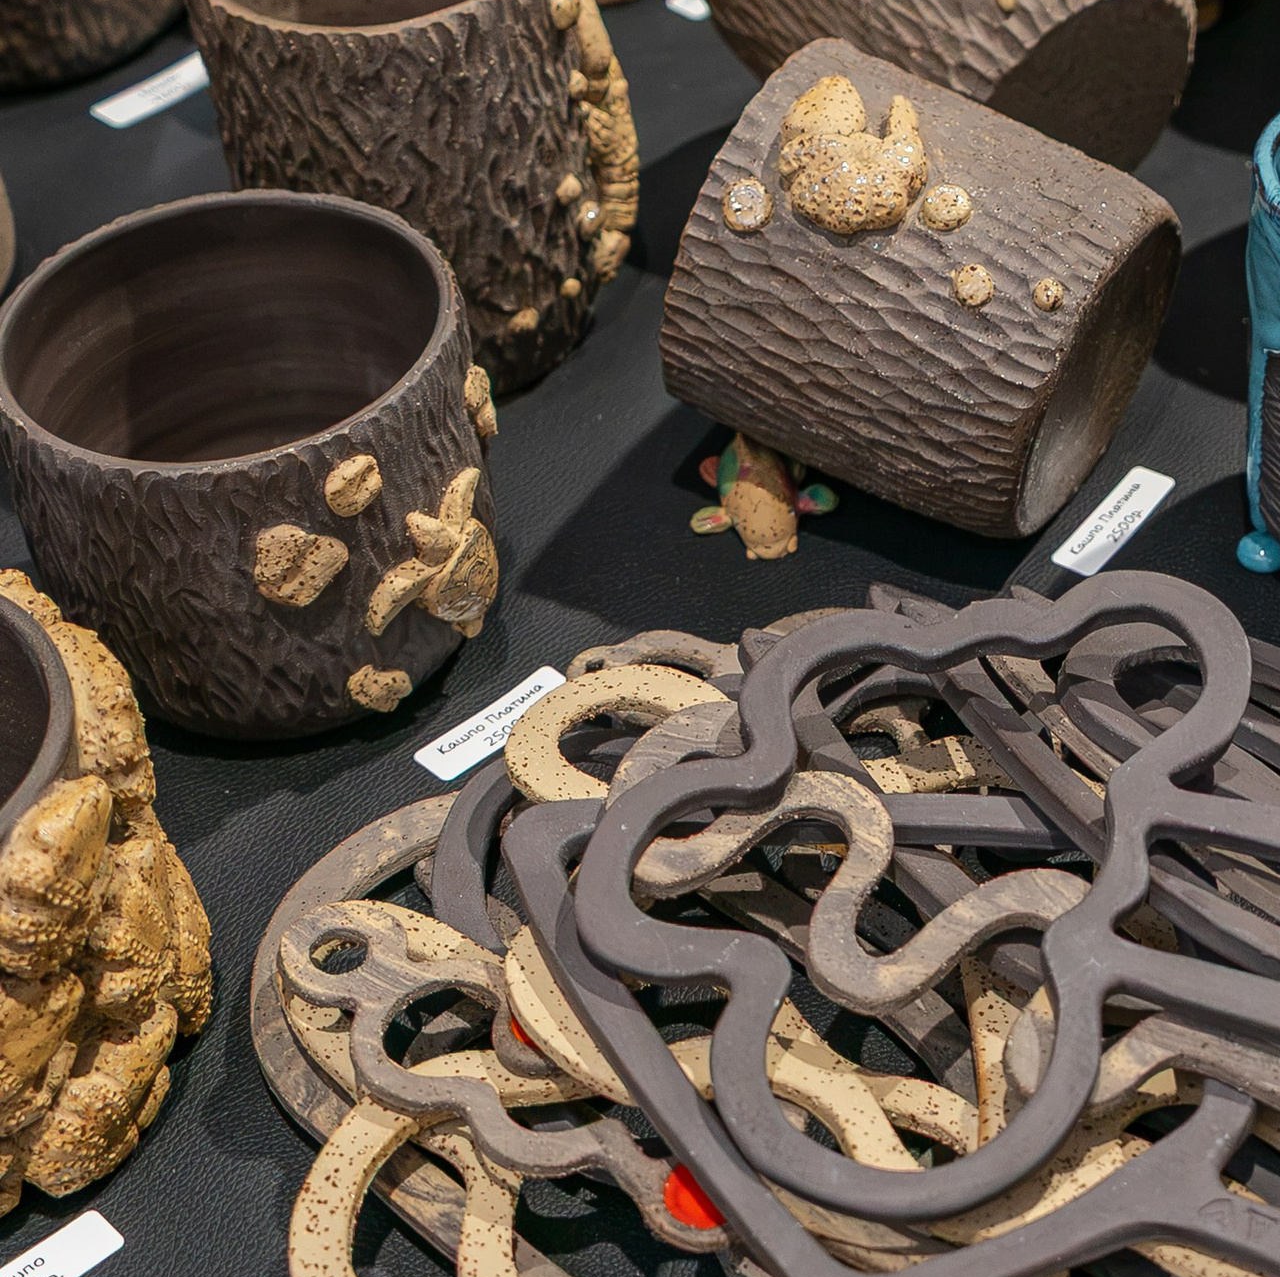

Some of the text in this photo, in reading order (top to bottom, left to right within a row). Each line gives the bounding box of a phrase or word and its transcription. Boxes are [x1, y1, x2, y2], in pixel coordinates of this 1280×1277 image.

[1069, 483, 1142, 555] Кашпо Платина
[436, 684, 544, 755] Кашпо Платина
